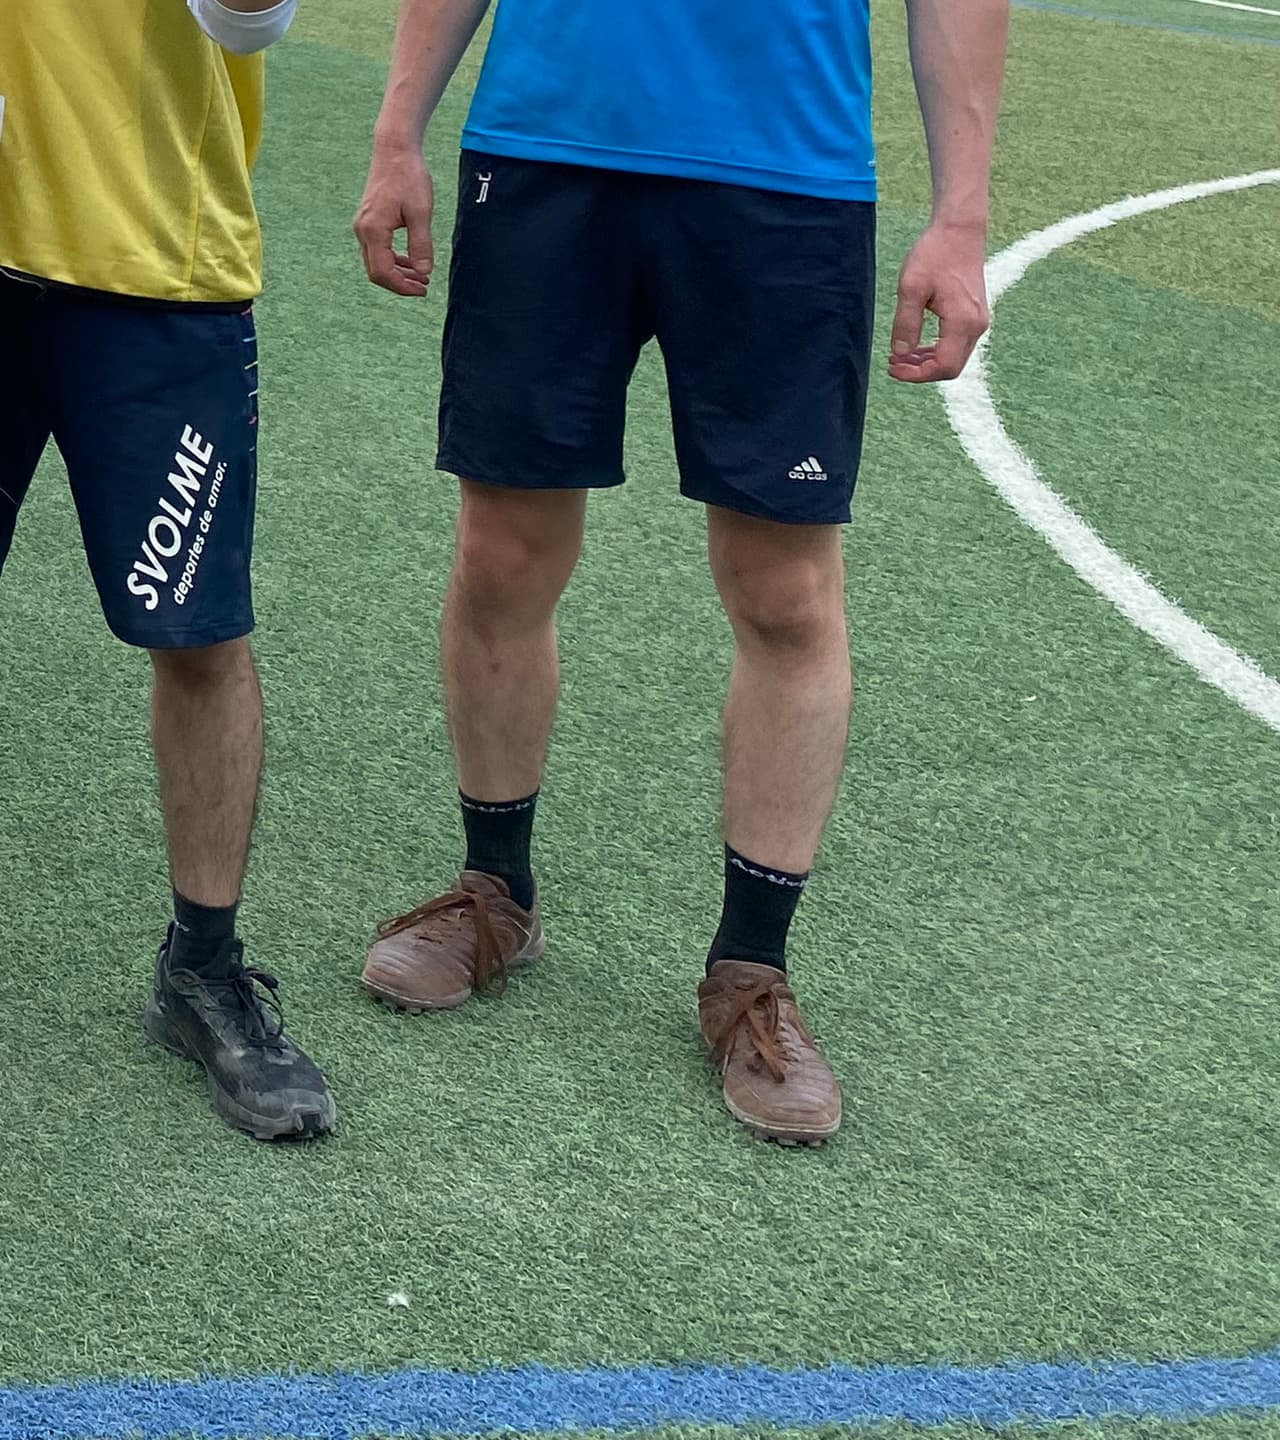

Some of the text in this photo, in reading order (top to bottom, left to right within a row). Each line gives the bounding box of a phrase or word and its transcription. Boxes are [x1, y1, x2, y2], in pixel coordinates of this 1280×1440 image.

[125, 423, 215, 611] SVOLME
[172, 461, 228, 606] deportes de amor.
